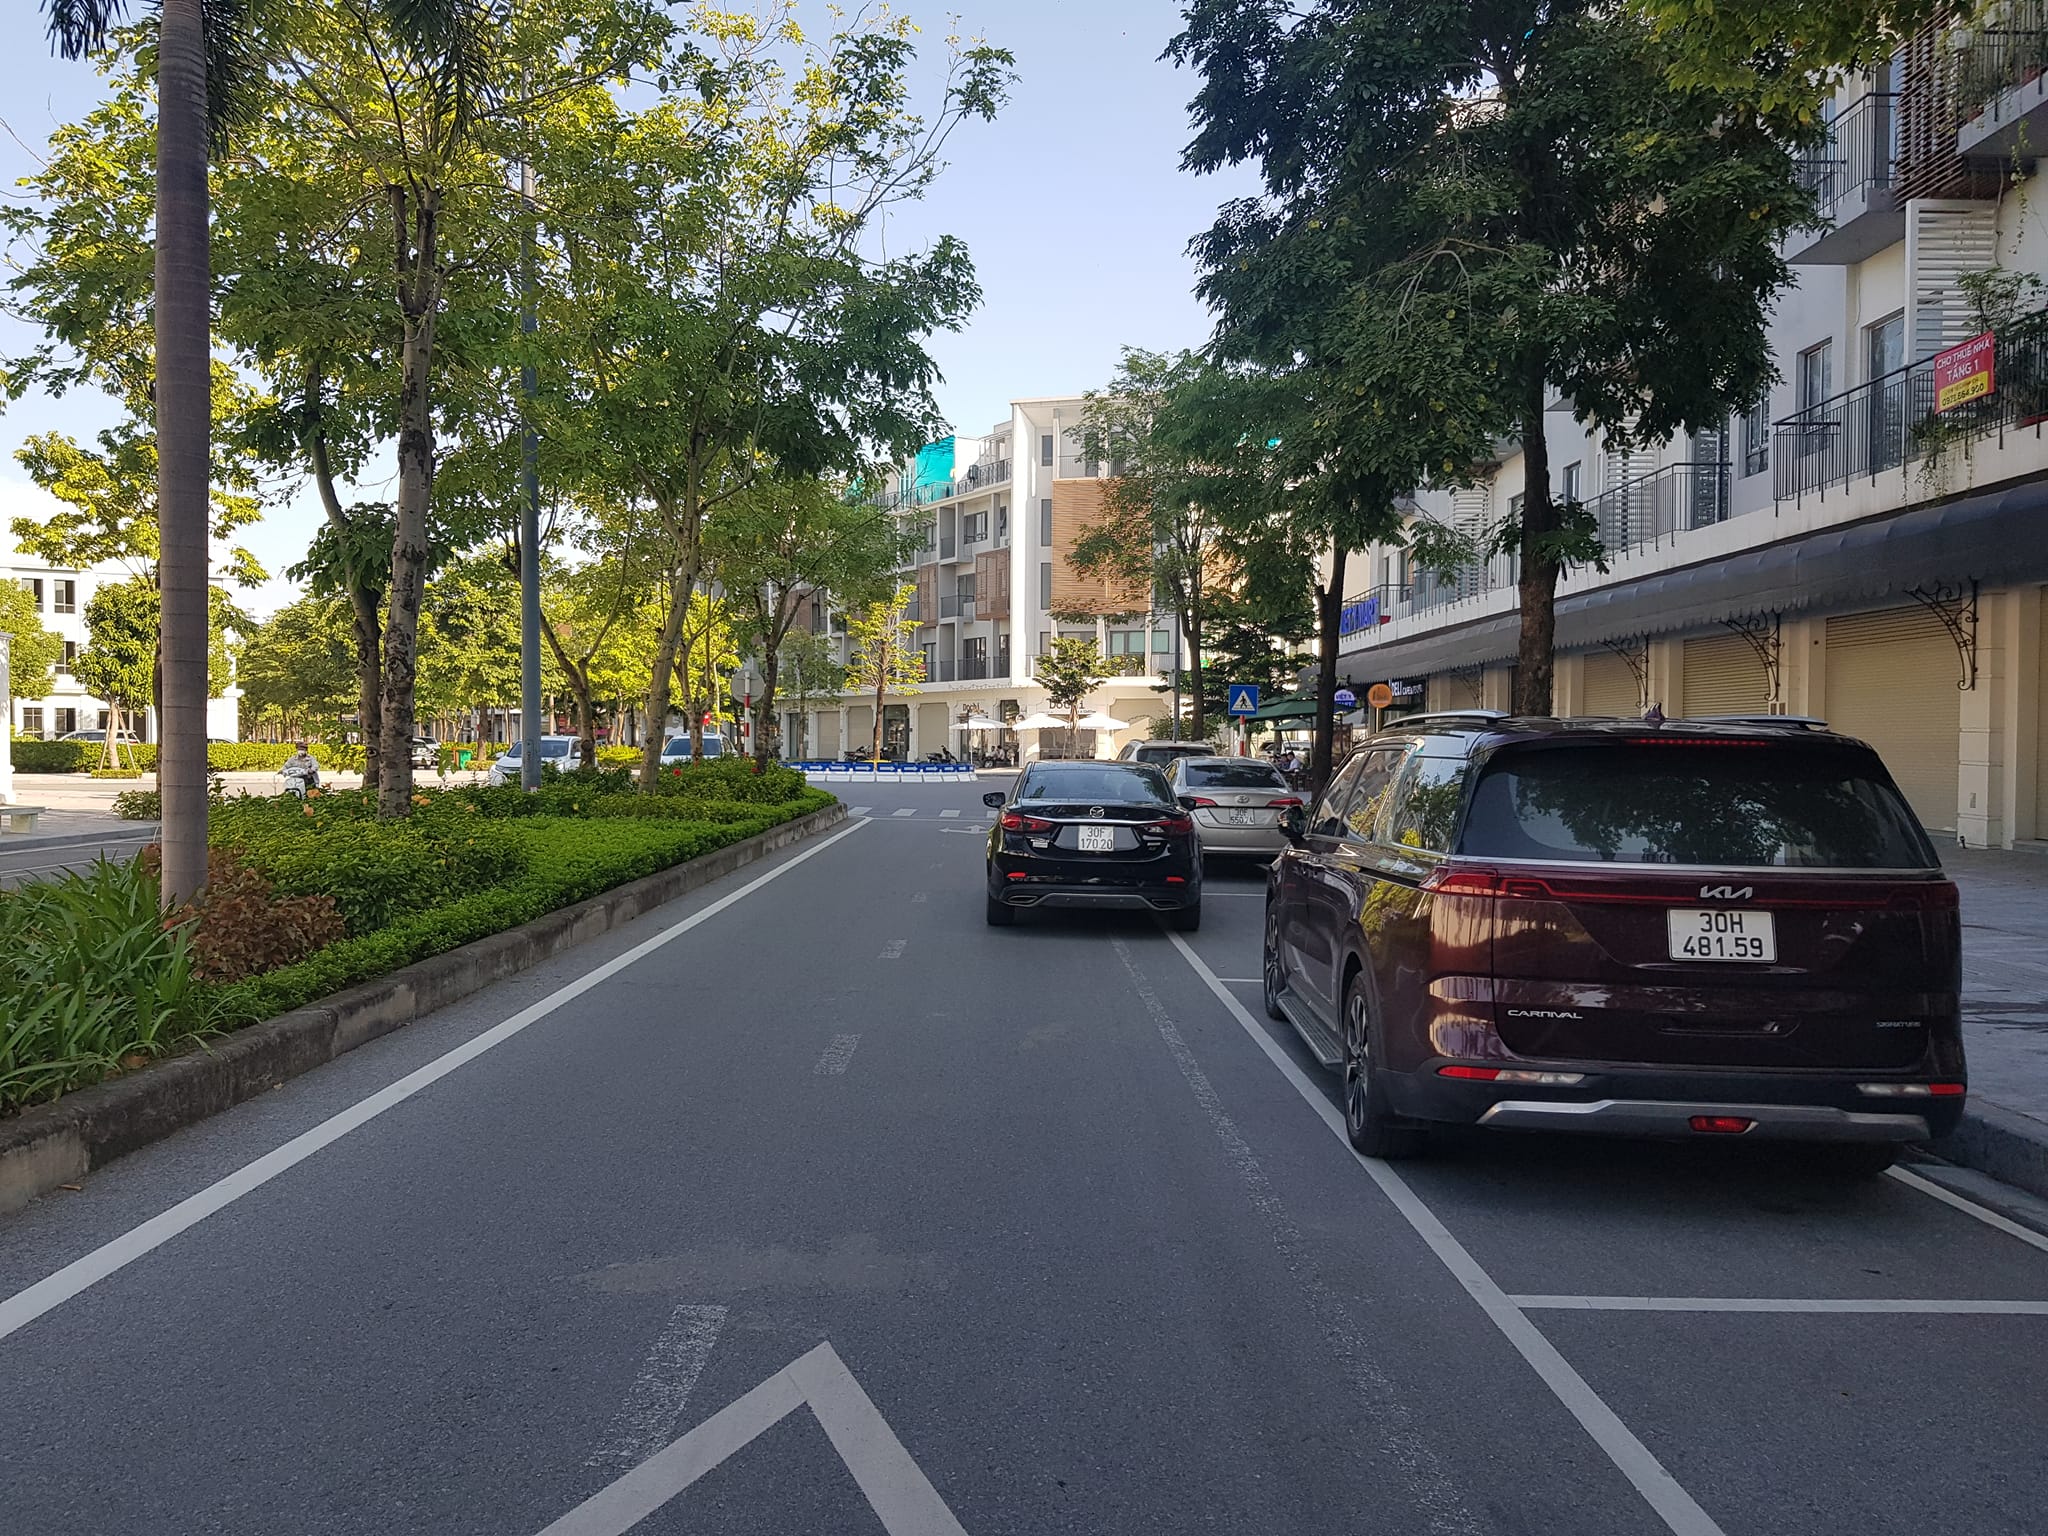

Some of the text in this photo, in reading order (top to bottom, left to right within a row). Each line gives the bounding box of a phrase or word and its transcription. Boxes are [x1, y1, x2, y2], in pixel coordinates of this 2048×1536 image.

[1936, 355, 1952, 369] CHO
[1953, 344, 1973, 362] THUÊ
[1974, 359, 1979, 371] 1
[1087, 827, 1105, 838] 30F
[1700, 885, 1753, 900] KIA
[1699, 912, 1744, 933] 30H
[1682, 935, 1764, 958] 481.59
[1507, 1009, 1583, 1020] CARNIVAL
